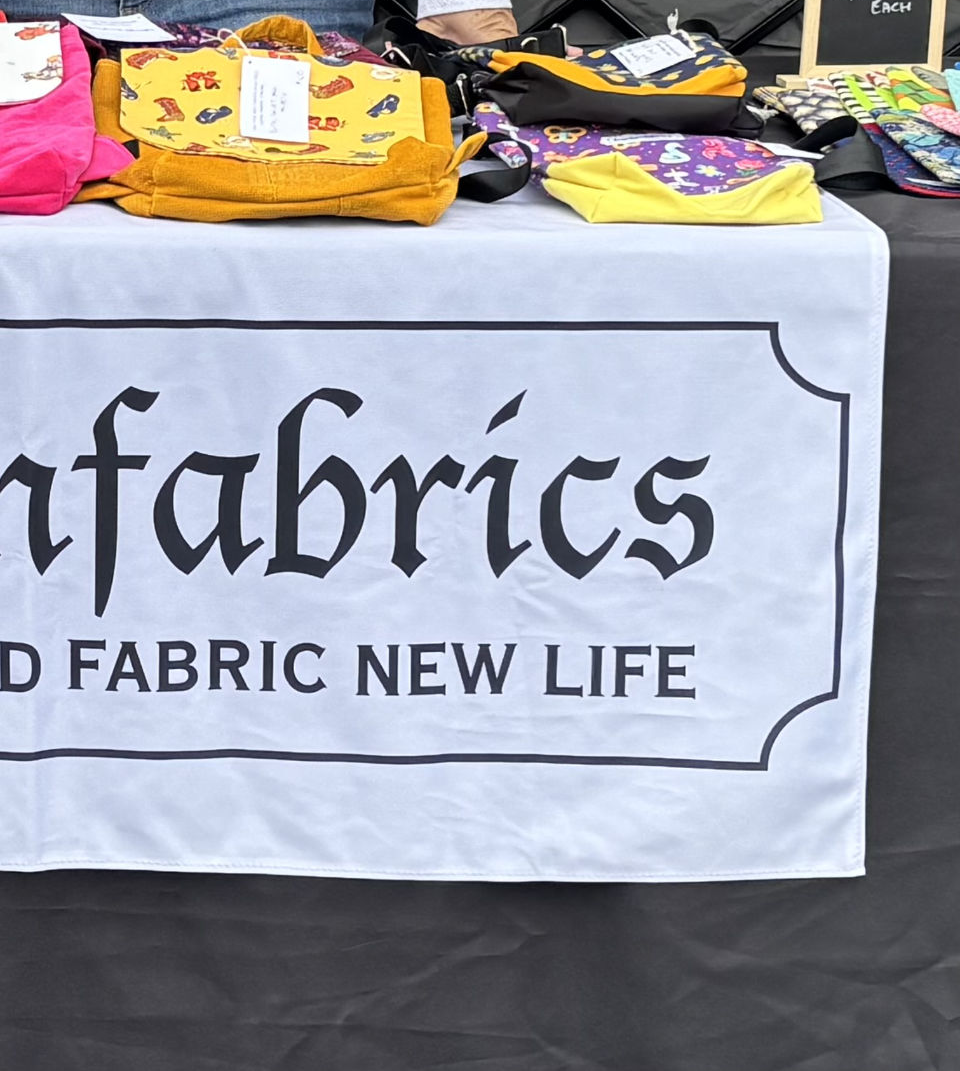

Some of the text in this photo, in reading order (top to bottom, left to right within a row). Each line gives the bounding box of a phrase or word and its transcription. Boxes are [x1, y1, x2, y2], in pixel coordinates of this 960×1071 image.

[870, 0, 912, 15] EACH
[67, 640, 326, 694] FABRIC
[356, 642, 517, 696] NEW
[545, 645, 696, 699] LIFE
